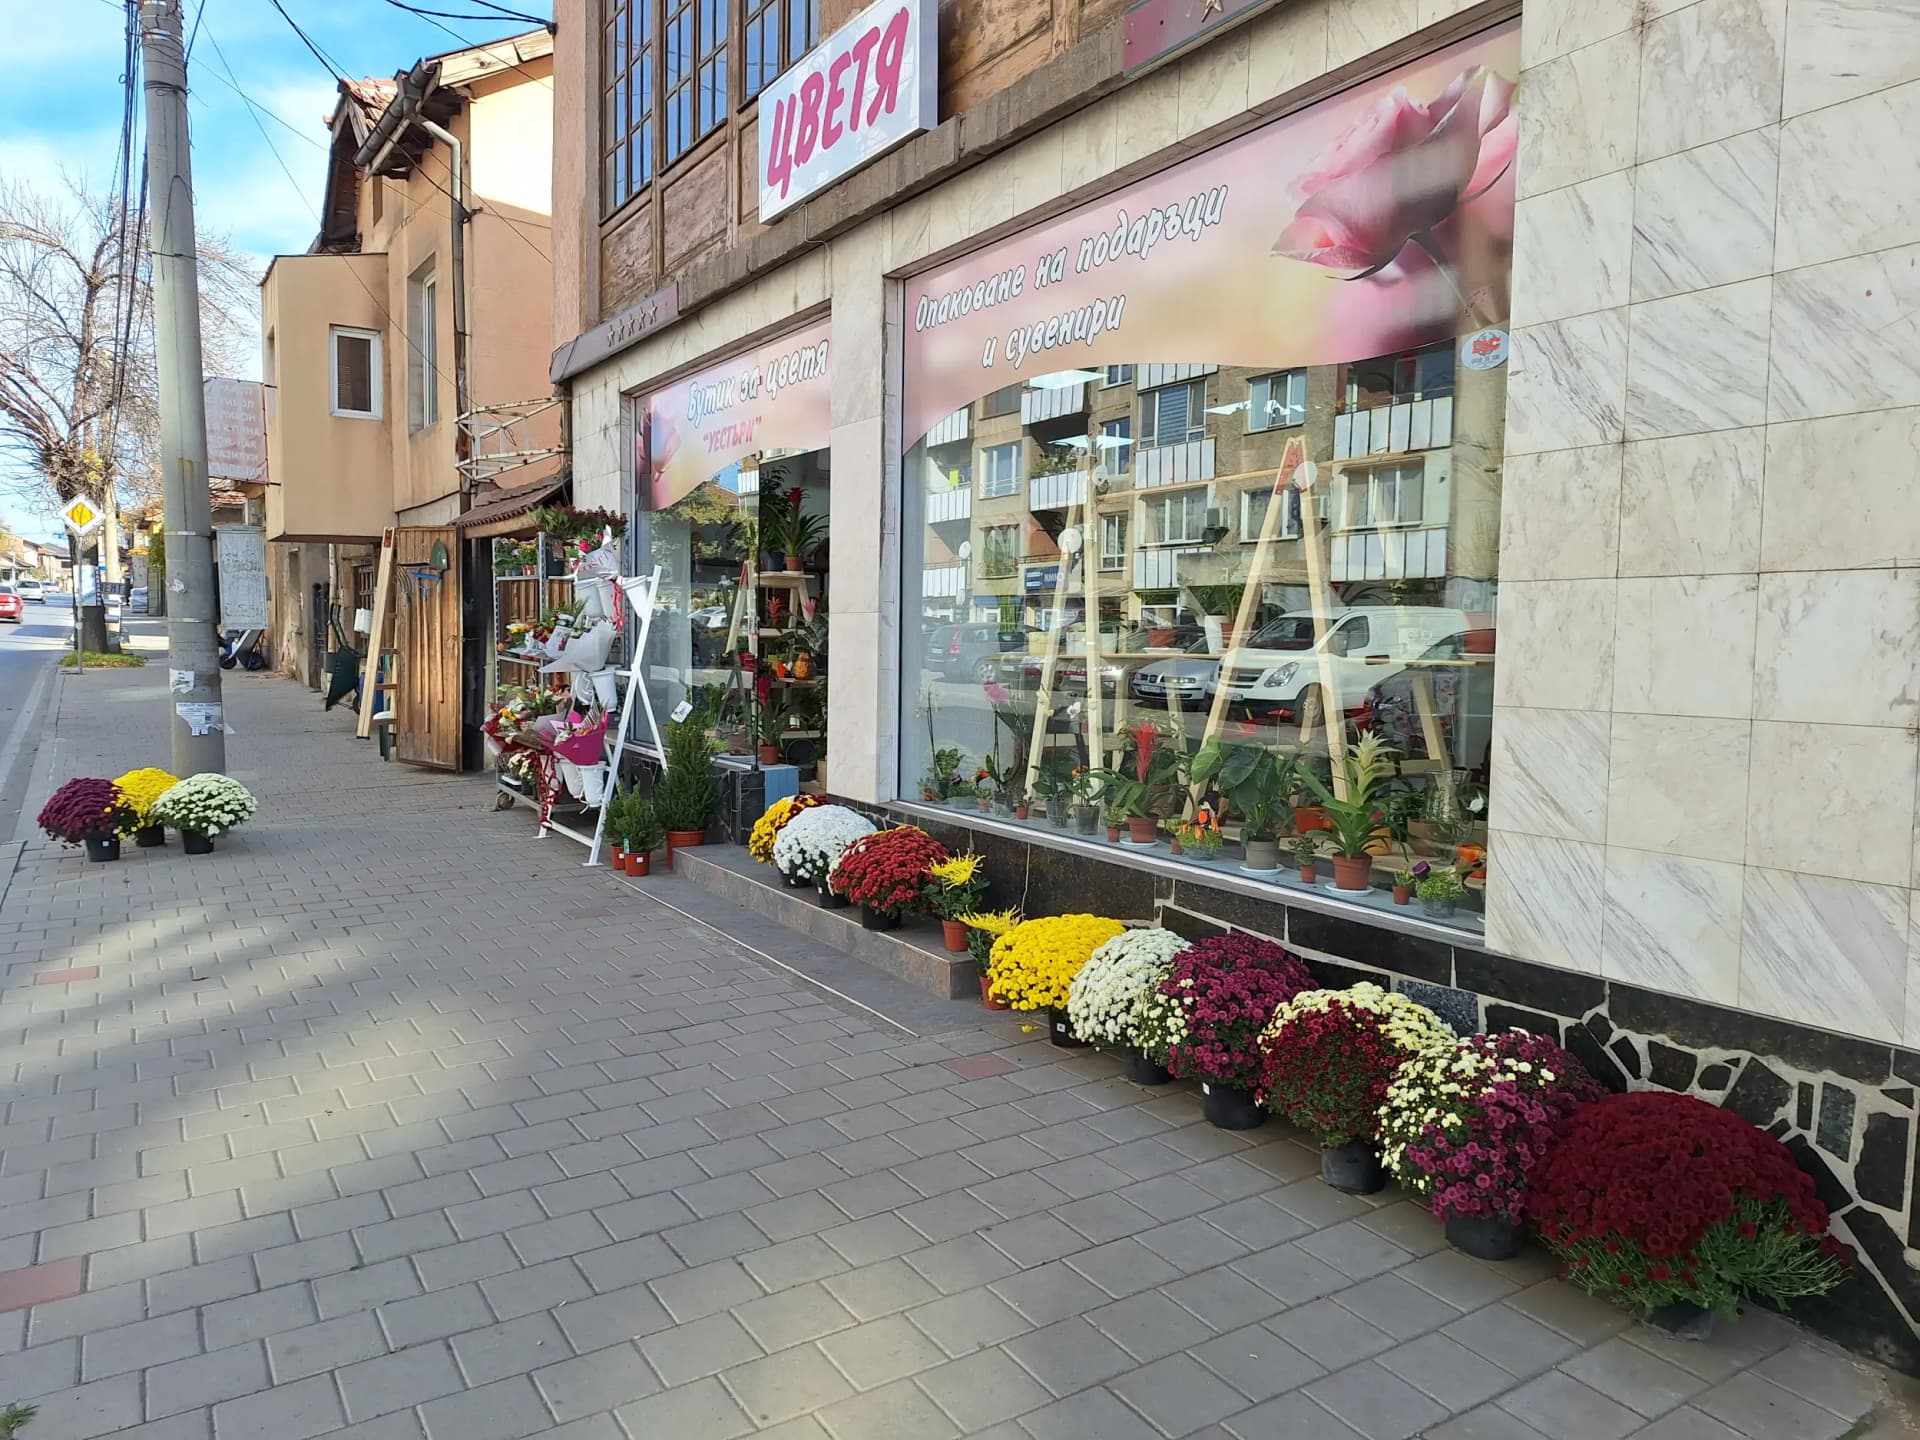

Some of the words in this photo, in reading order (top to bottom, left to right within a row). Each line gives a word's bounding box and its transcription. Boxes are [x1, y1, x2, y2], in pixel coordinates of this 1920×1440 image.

[767, 6, 910, 200] ЦВЕТЯ
[914, 264, 1026, 332] Опаковане
[1034, 246, 1068, 289] на
[1075, 184, 1229, 273] подаръци
[687, 377, 736, 430] Бутик
[739, 366, 761, 402] за
[766, 338, 830, 401] цветя
[981, 336, 999, 368] и
[1004, 294, 1127, 369] сувенири
